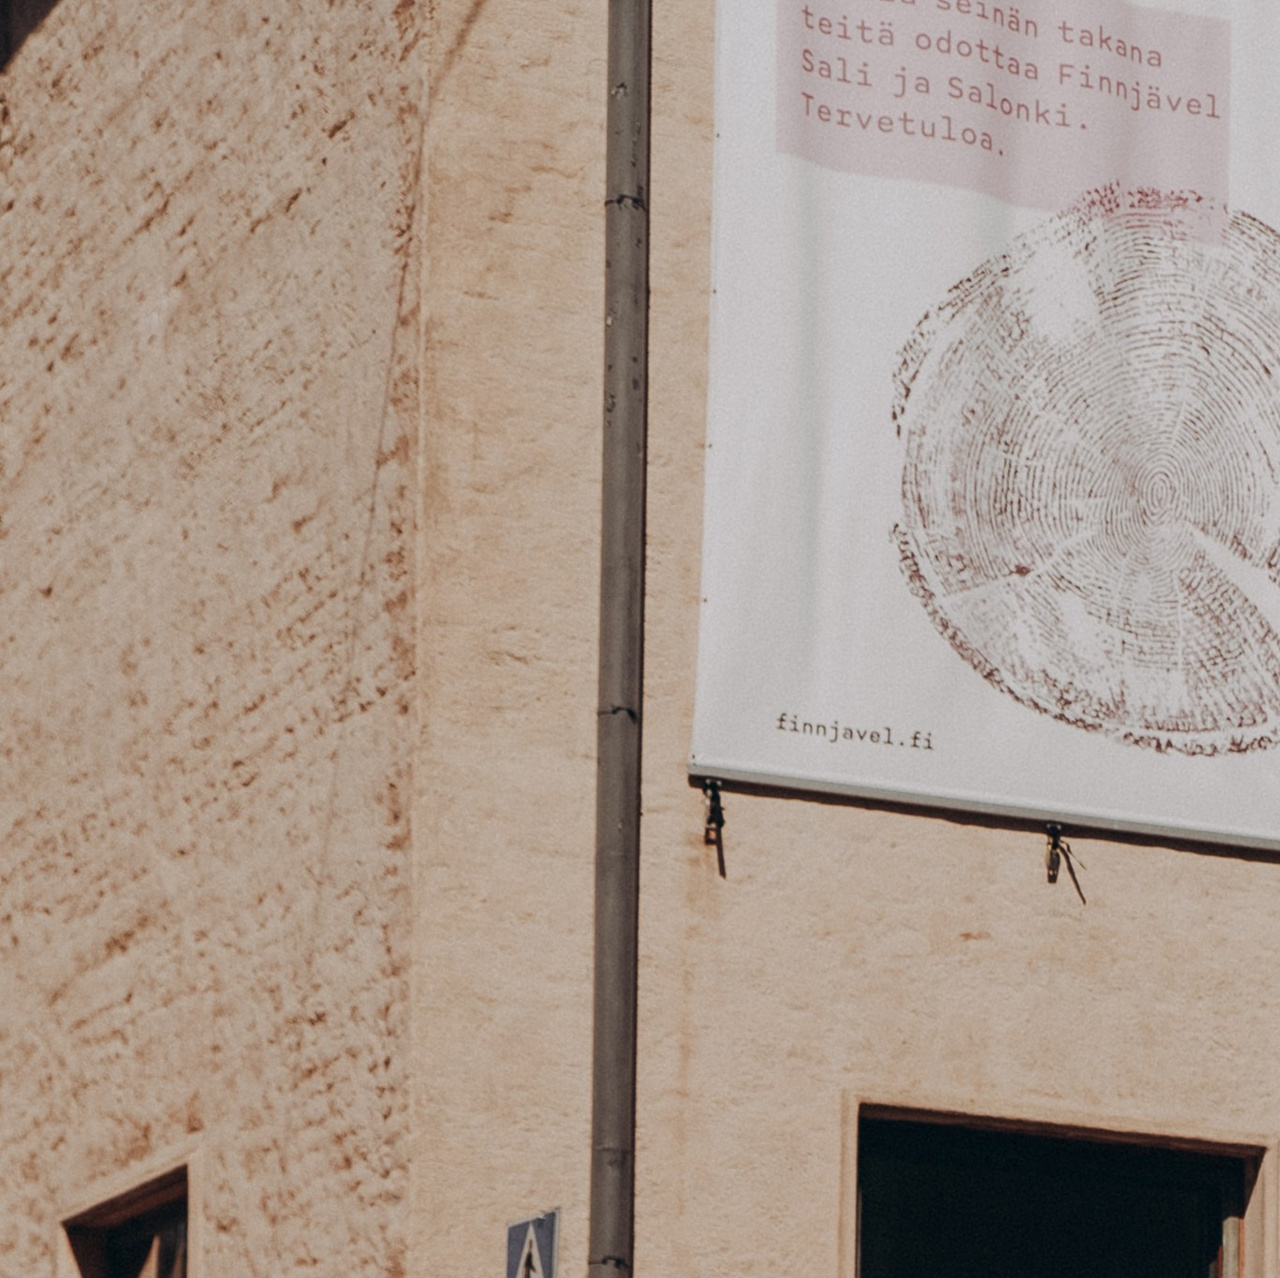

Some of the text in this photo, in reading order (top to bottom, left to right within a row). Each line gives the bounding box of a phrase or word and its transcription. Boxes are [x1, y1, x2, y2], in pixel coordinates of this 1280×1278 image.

[802, 5, 1220, 119] teitä odottaa Finnjävel
[1058, 20, 1162, 67] takana
[802, 48, 1086, 129] Sali ja Salonki.
[801, 92, 1003, 156] Tervetuloa.
[776, 713, 933, 749] finnjavel.fi
